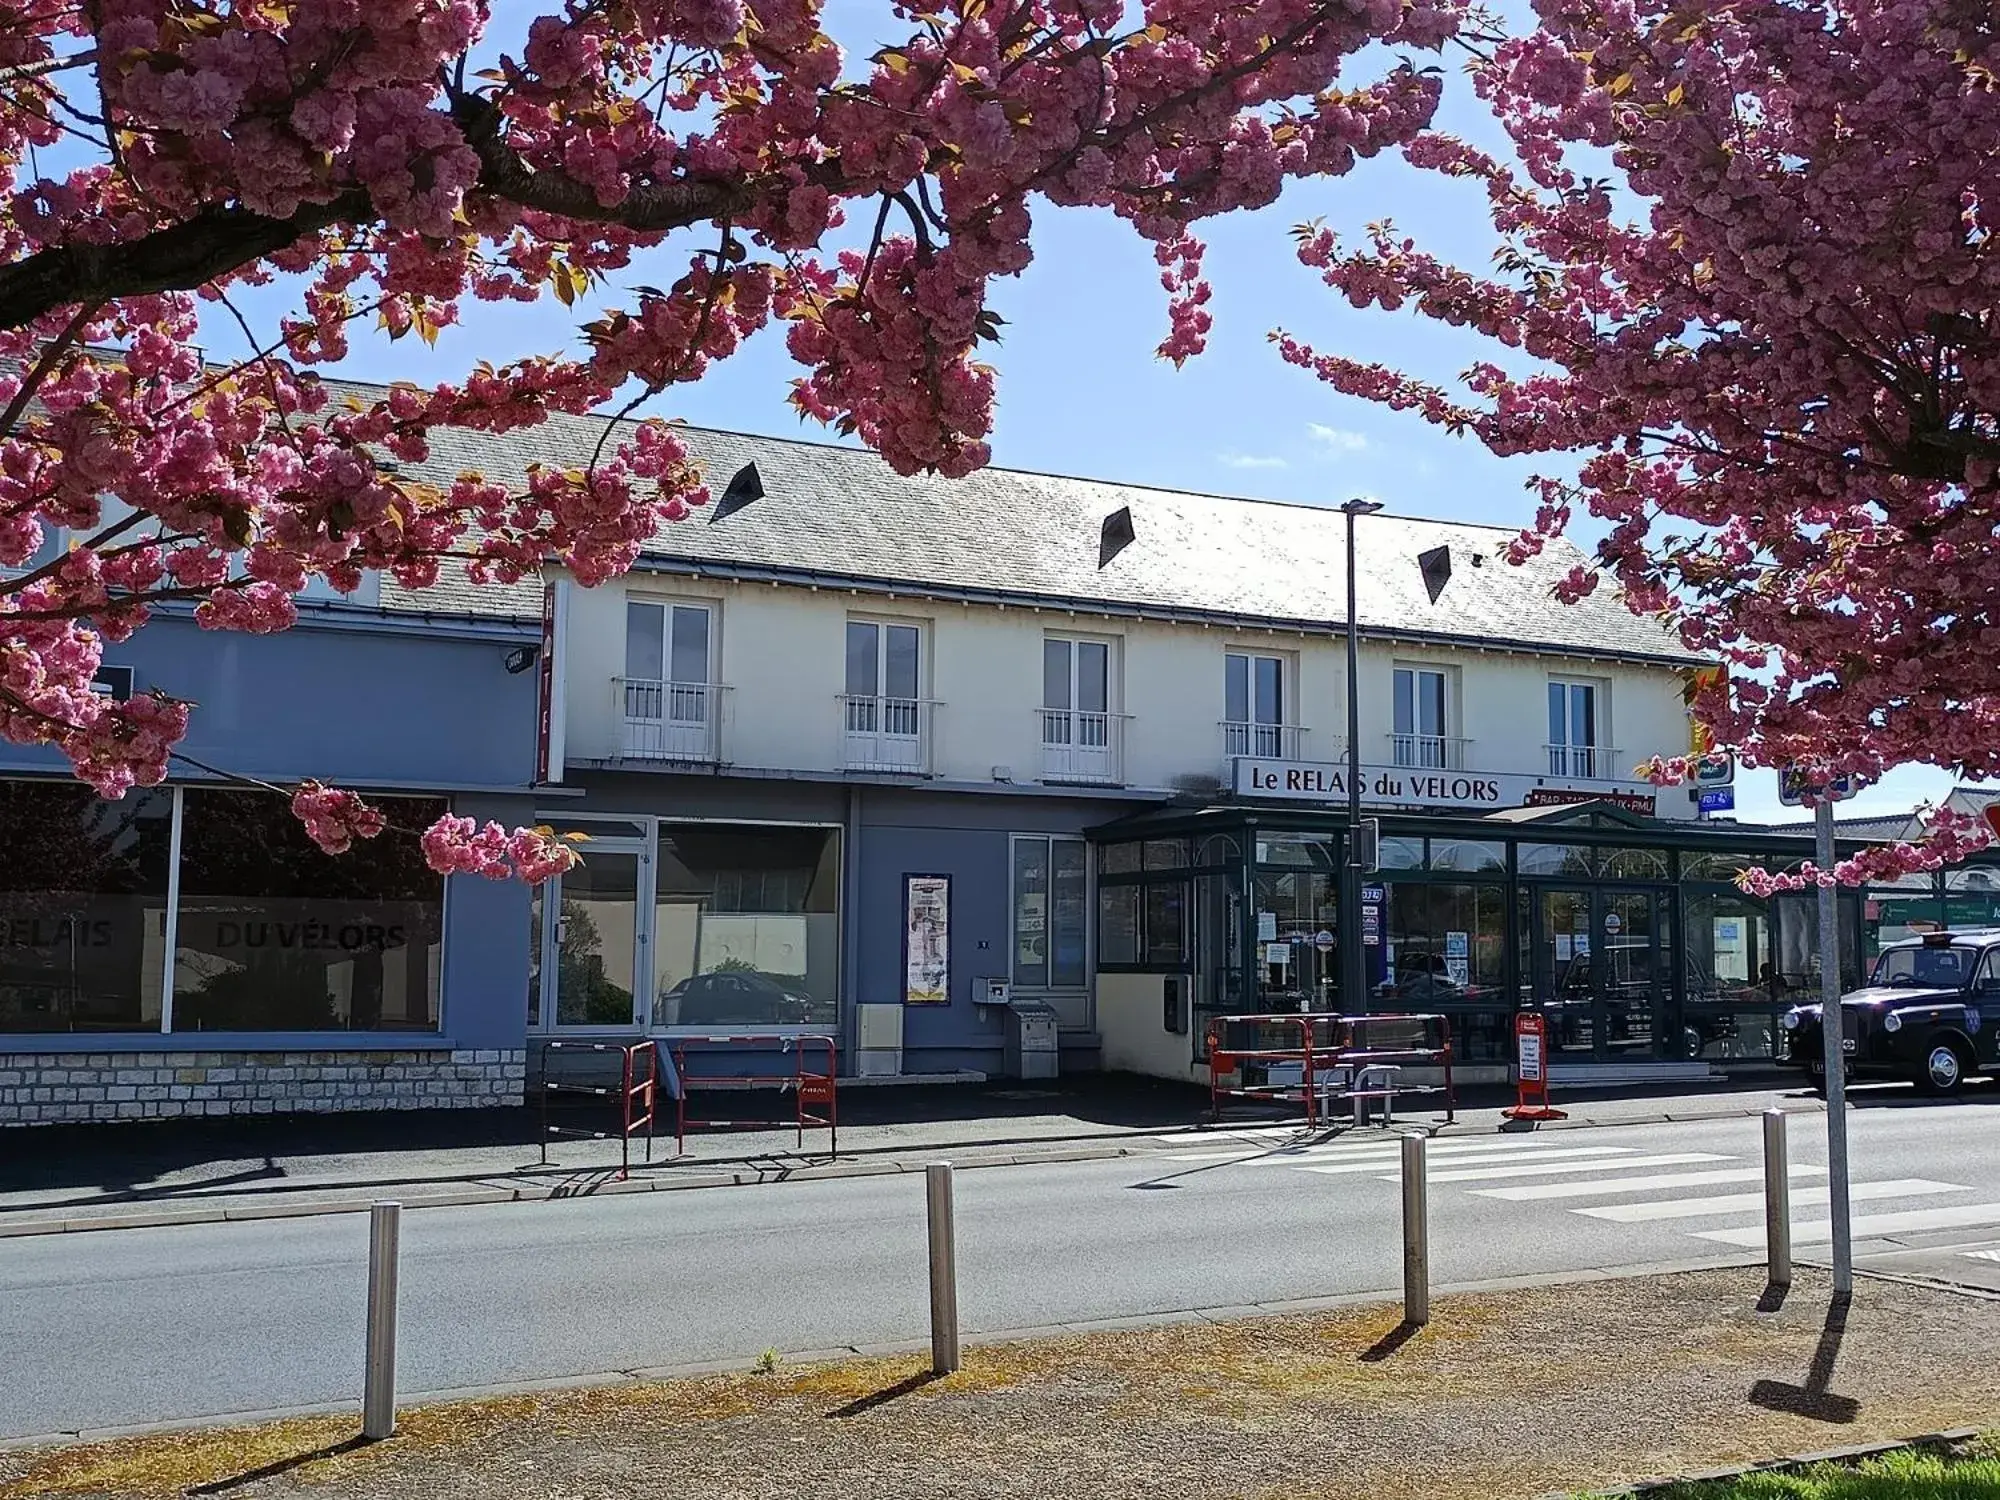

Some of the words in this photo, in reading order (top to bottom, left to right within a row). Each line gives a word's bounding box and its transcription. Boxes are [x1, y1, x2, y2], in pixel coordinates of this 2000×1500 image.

[1252, 767, 1278, 790] Le
[1374, 772, 1402, 796] du
[1409, 776, 1499, 802] VELORS
[1631, 800, 1654, 812] PMU
[216, 920, 268, 948] DU
[272, 916, 406, 951] VÉLORS
